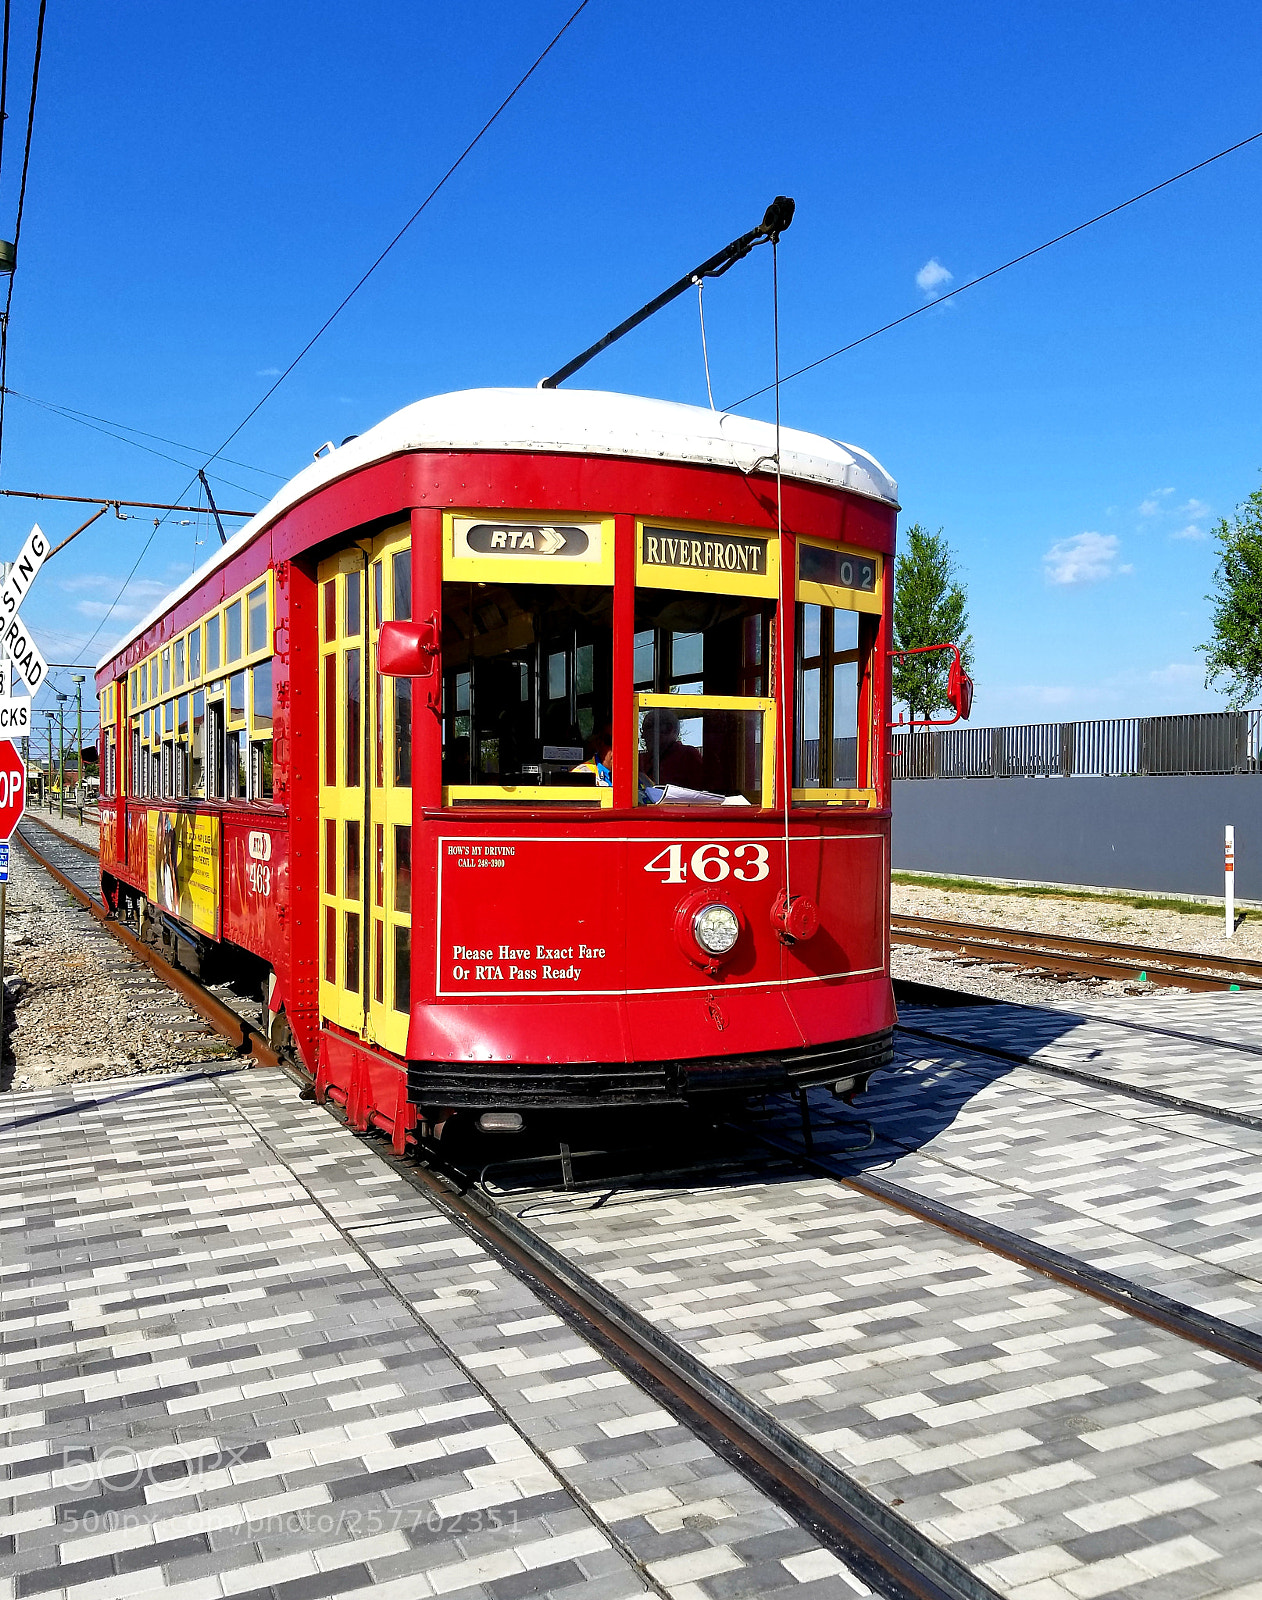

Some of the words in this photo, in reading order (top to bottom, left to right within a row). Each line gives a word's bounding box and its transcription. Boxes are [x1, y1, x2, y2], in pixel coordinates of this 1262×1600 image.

[490, 531, 535, 549] RTA
[646, 536, 762, 572] RIVERFRONT
[447, 845, 470, 856] HOW'S
[471, 846, 483, 856] MY
[484, 846, 516, 856] DRIVING
[457, 858, 476, 868] CALL
[643, 842, 770, 884] 463
[249, 862, 271, 897] 463
[453, 945, 494, 960] Please
[498, 945, 531, 960] Have
[535, 945, 574, 959] Exact
[578, 945, 606, 959] Fare
[452, 965, 471, 980] Or
[474, 965, 504, 980] RTA
[509, 965, 537, 980] Pass
[541, 965, 582, 981] Ready
